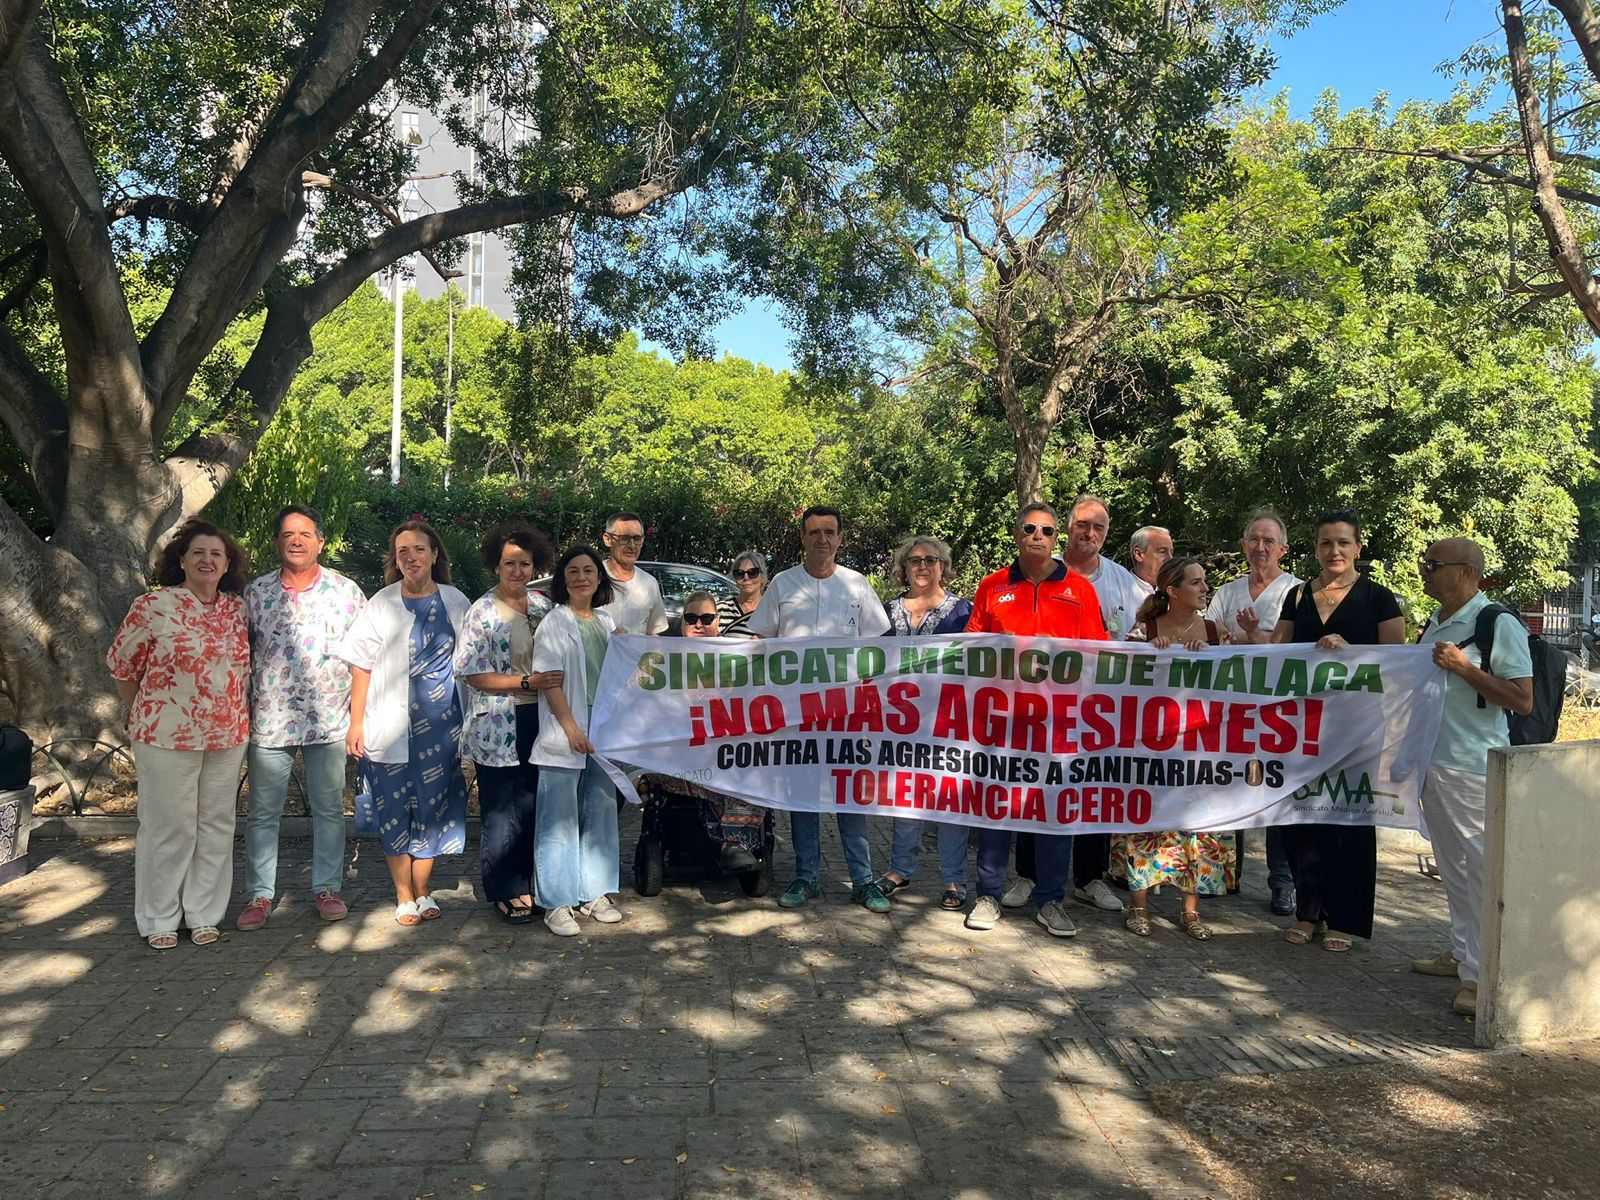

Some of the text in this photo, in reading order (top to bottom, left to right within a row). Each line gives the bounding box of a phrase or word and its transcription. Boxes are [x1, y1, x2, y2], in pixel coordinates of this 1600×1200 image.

[640, 641, 1384, 696] SINDICATO MÉDICO DE MÁLAGA
[799, 679, 921, 735] MÁS
[933, 683, 1323, 756] AGRESIONES!
[717, 739, 1285, 788] CONTRA LAS AGRESIONES A SANITARIAS-OS
[831, 769, 1152, 825] TOLERANCIA CERO
[1294, 804, 1329, 812] Sindicato
[1331, 805, 1361, 814] Médico
